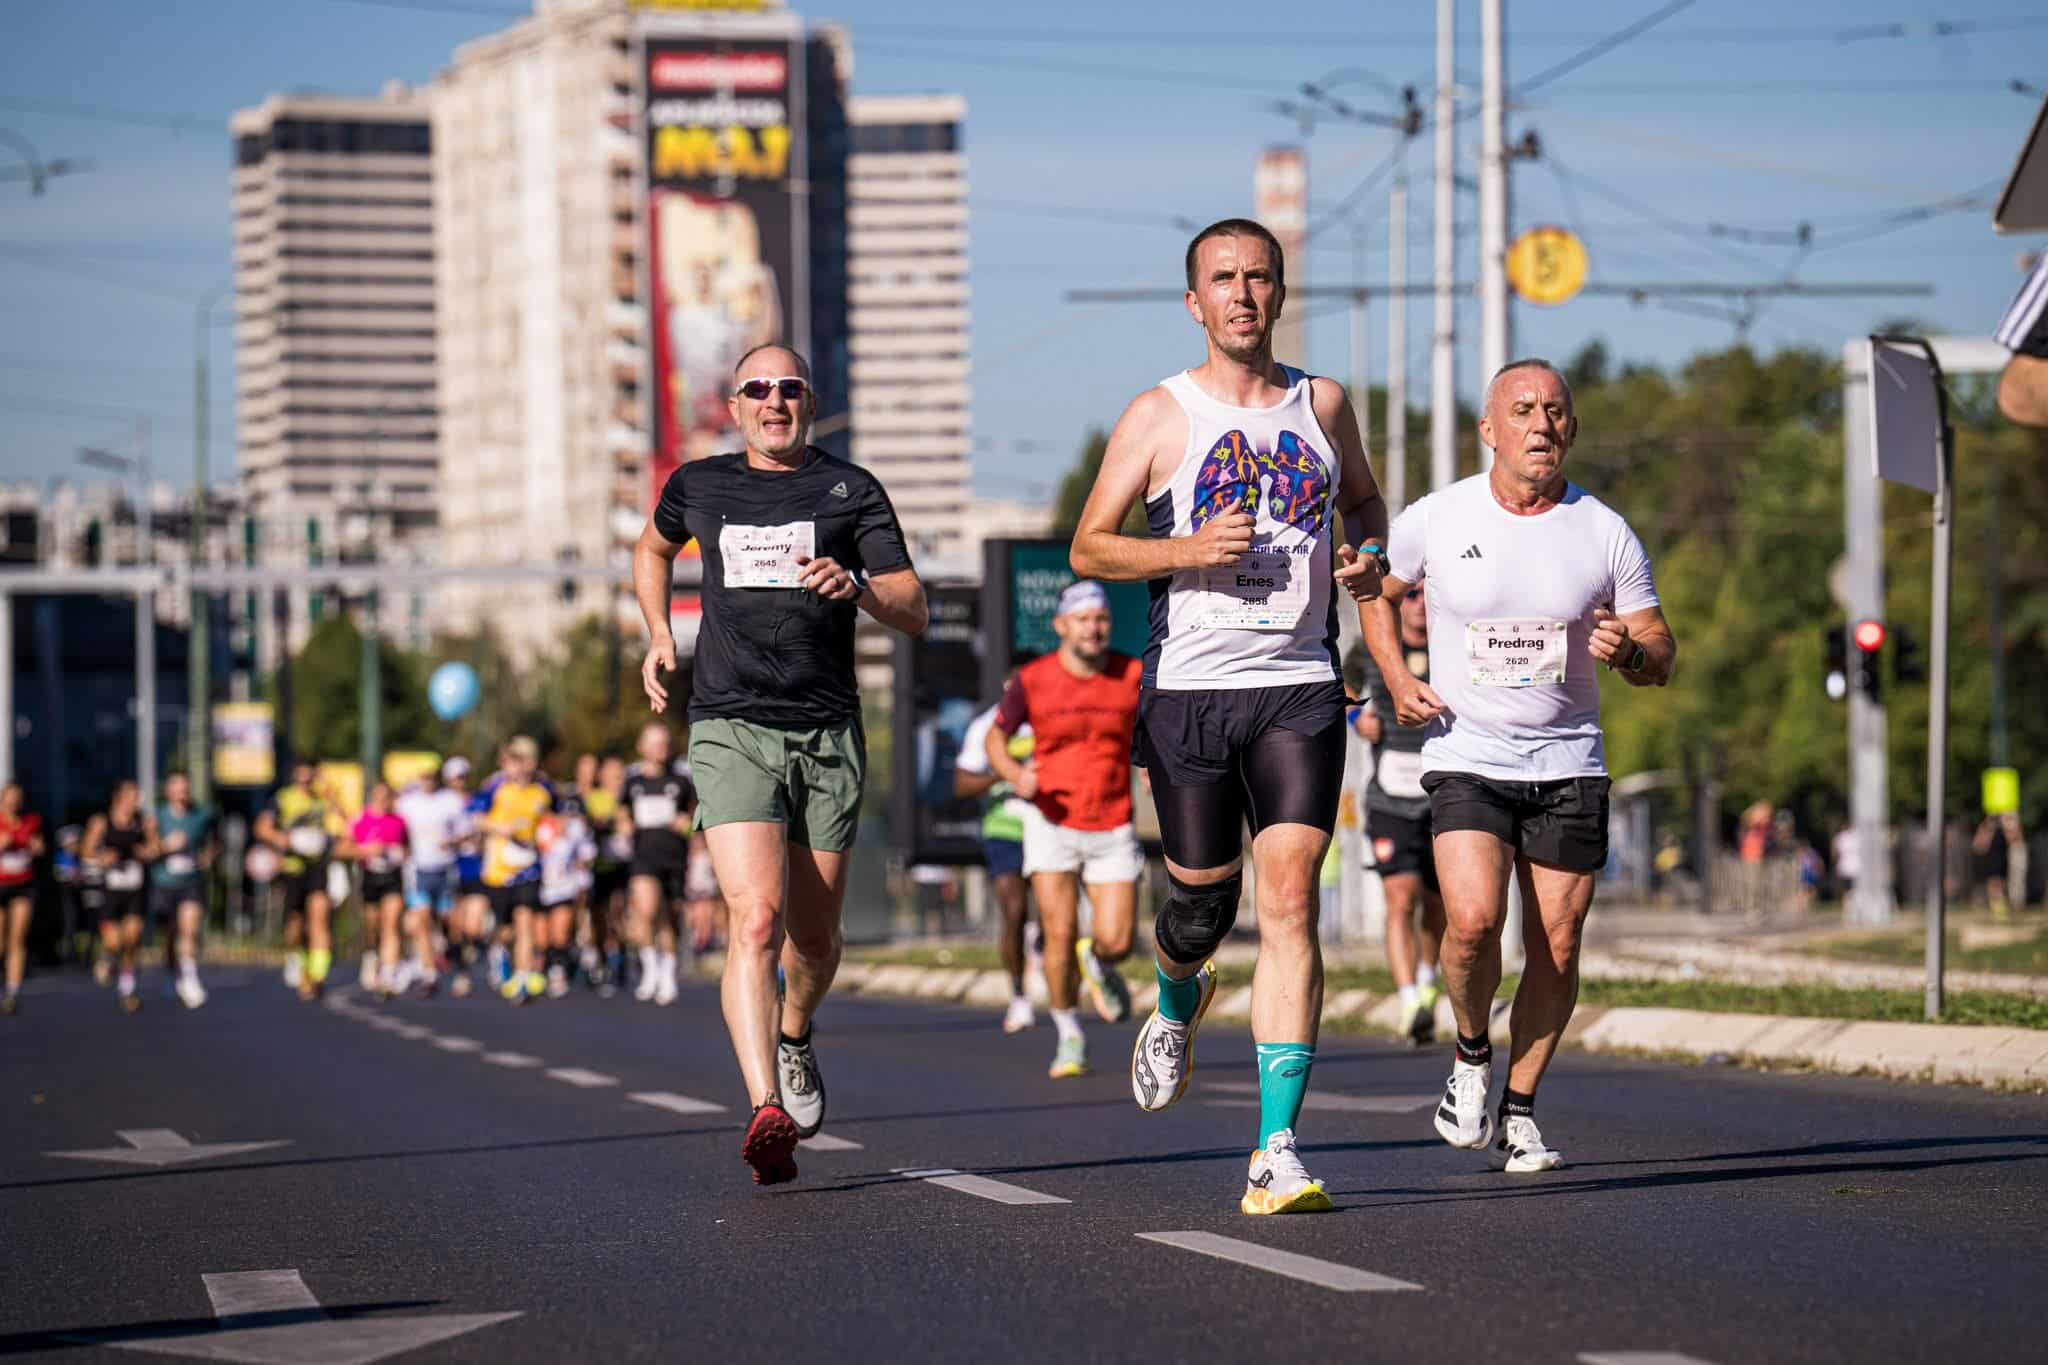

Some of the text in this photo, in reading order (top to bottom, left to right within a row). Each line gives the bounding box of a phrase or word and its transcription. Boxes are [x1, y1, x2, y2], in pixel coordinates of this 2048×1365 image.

[1236, 575, 1275, 587] Enes
[1488, 638, 1544, 651] Predrag
[1505, 657, 1529, 665] 2620
